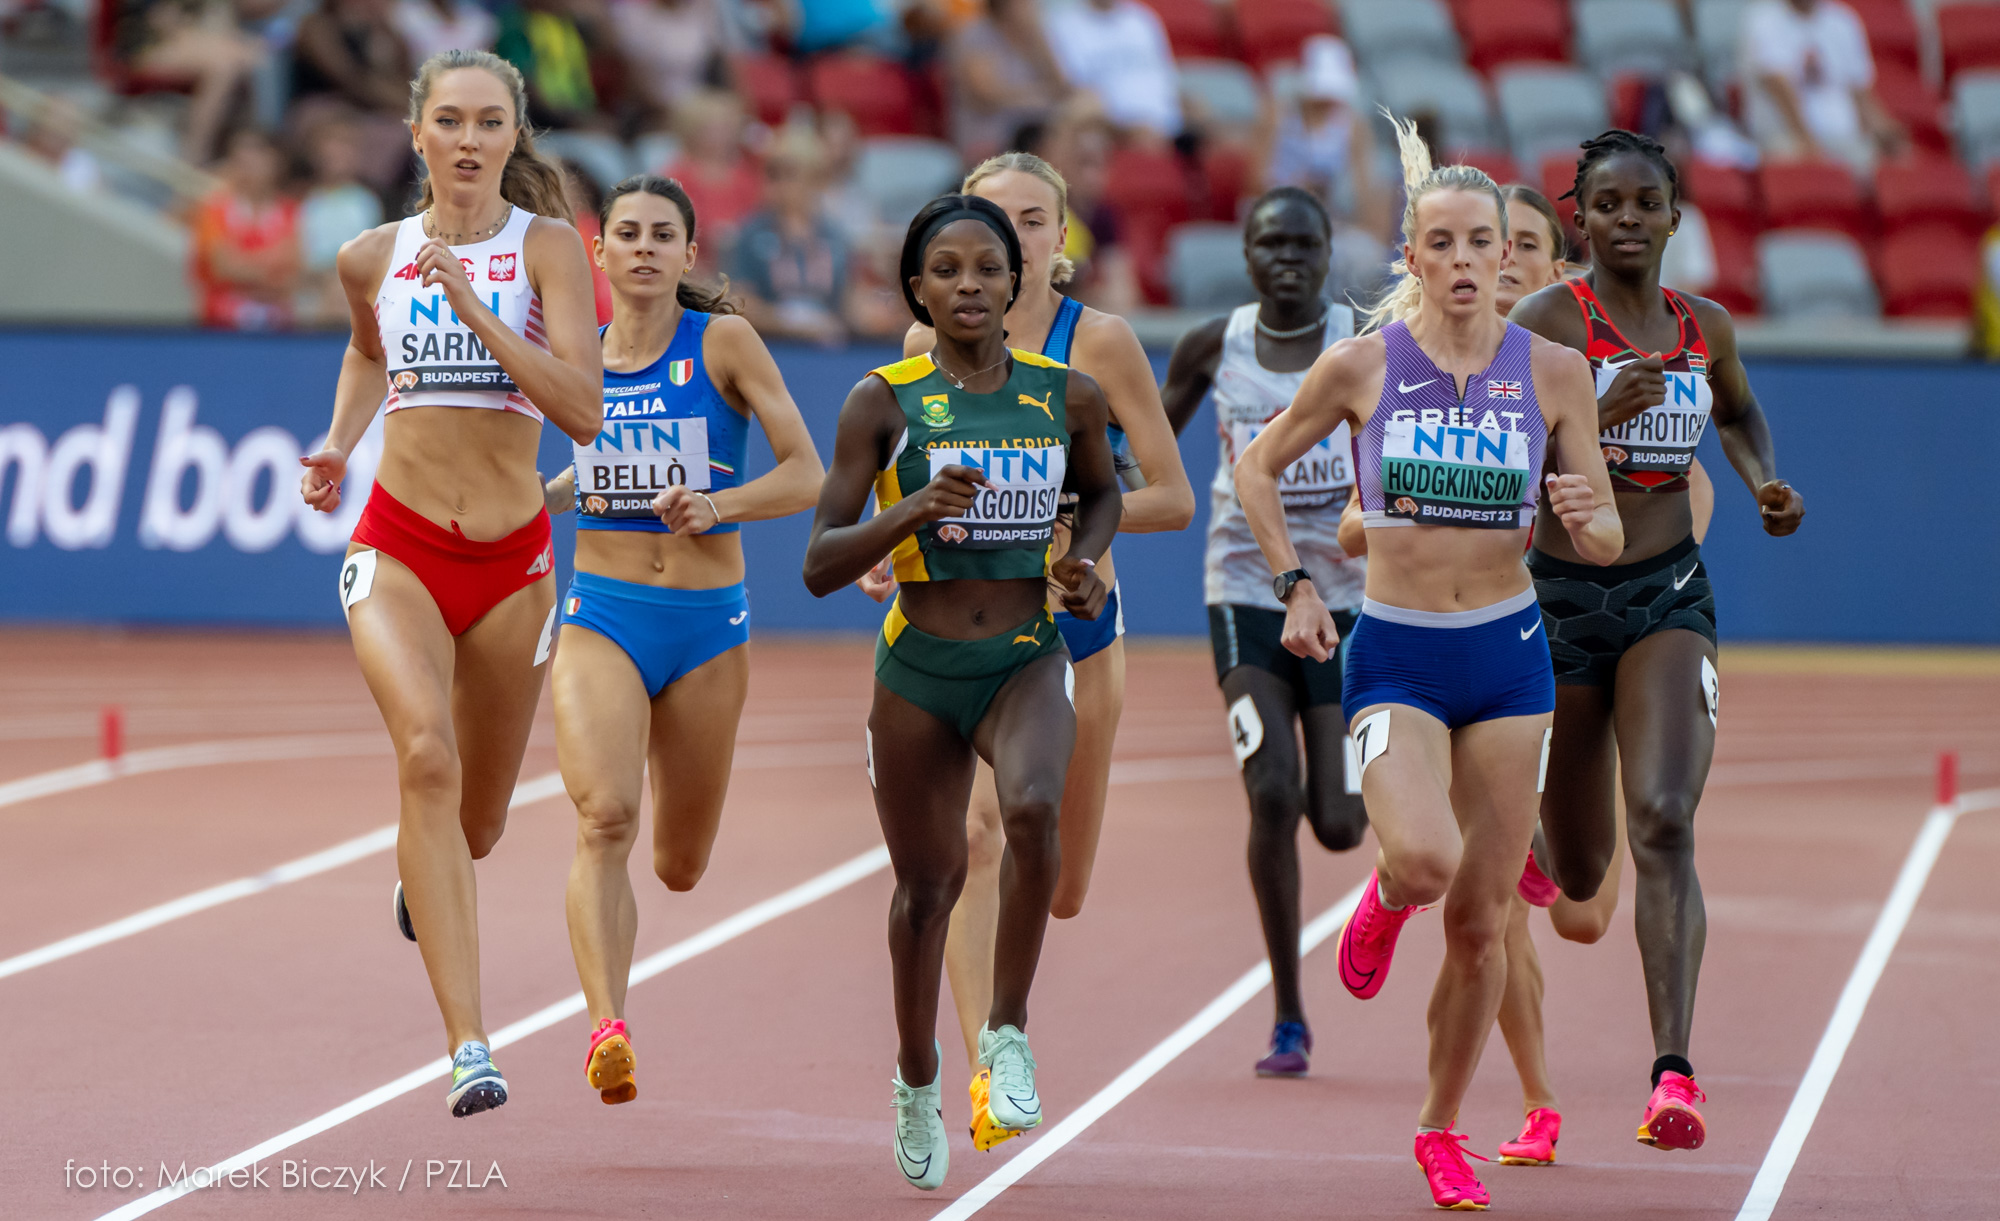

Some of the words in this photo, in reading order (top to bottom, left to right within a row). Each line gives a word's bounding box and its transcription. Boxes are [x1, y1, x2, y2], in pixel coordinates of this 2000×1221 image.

[422, 372, 500, 383] BUDAPEST
[603, 397, 667, 418] TALIA
[595, 422, 681, 453] NTN
[1413, 425, 1508, 465] NTN
[139, 384, 384, 553] boo
[593, 457, 686, 491] BELLÒ
[961, 449, 1048, 482] NTN
[1388, 461, 1523, 501] HODGKINSON
[1422, 504, 1497, 521] BUDAPEST
[1498, 510, 1513, 521] 23
[973, 528, 1044, 541] BUDAPEST
[344, 563, 358, 605] 9
[1234, 714, 1249, 748] 4
[1357, 722, 1372, 766] 7
